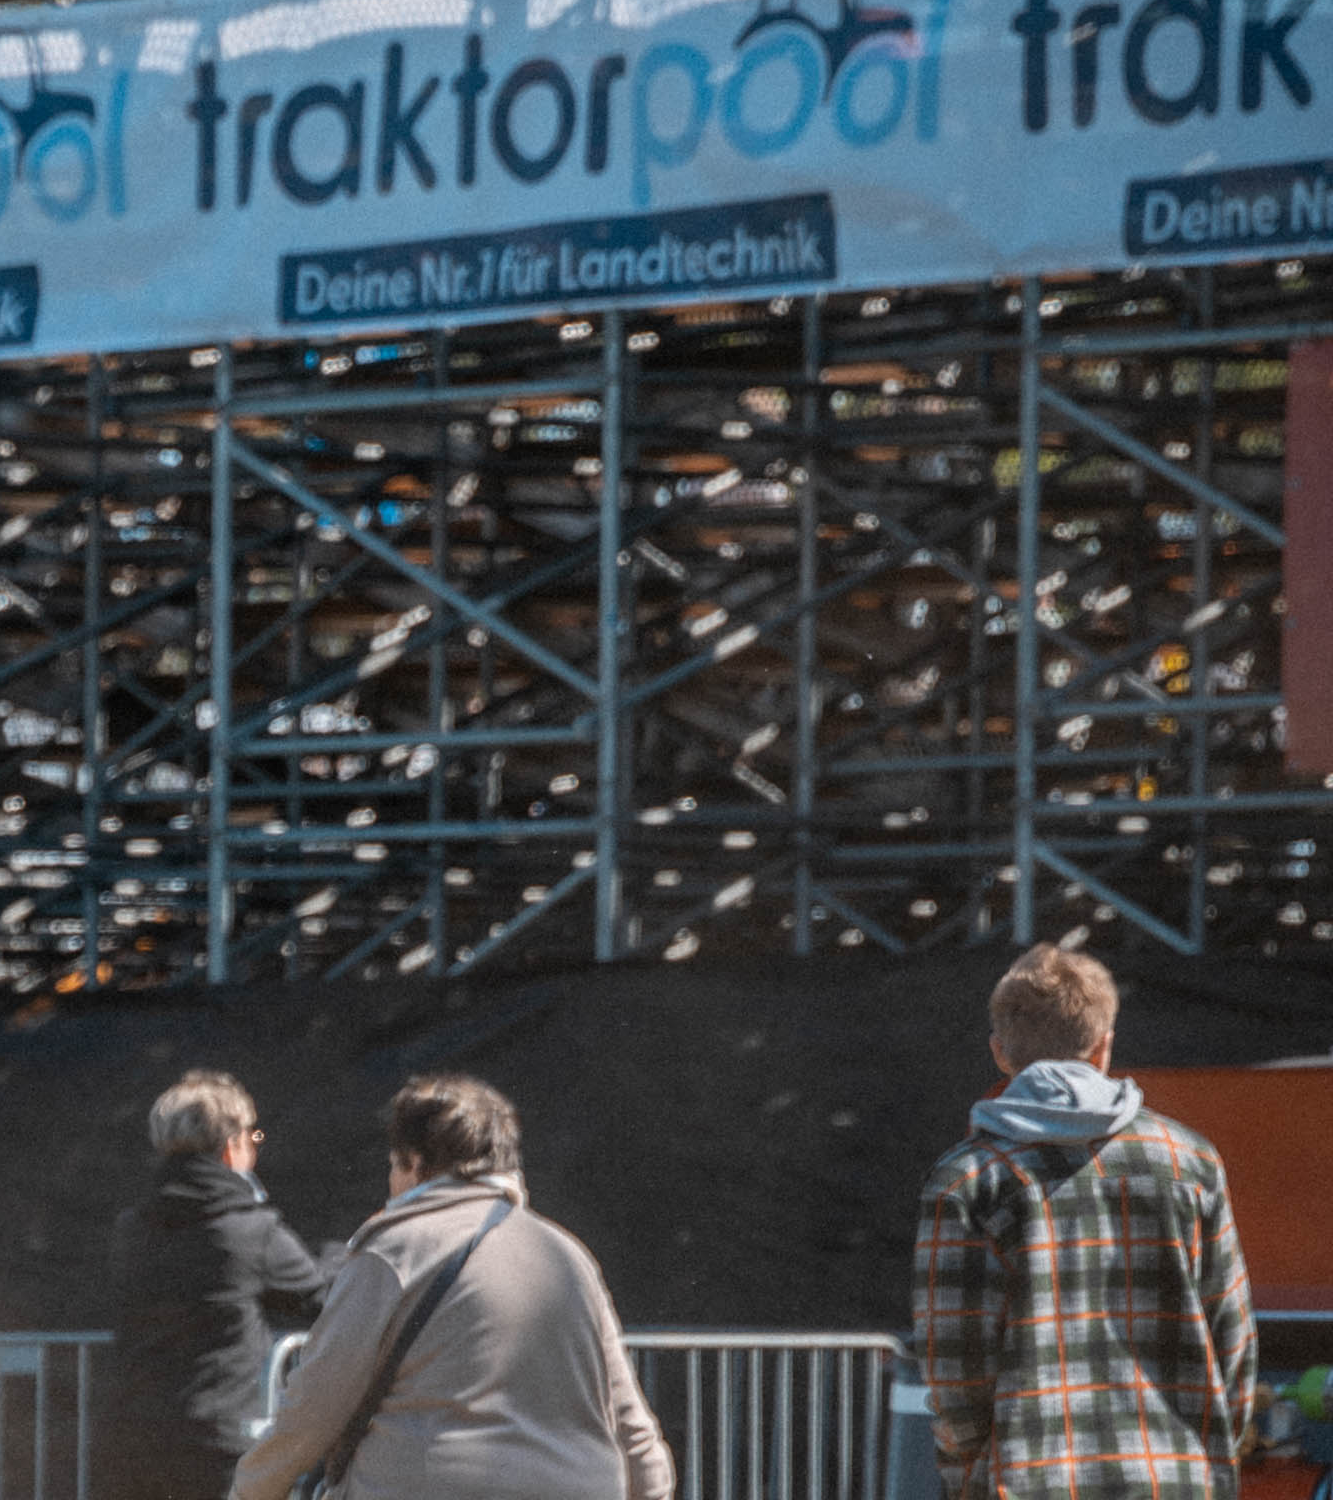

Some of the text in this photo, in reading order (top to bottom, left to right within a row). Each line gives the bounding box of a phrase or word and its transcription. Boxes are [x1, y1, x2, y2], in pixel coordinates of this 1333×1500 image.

[1140, 183, 1278, 245] Deine
[295, 259, 412, 314] Deine
[497, 239, 551, 294] für
[557, 221, 826, 291] Landtechnik
